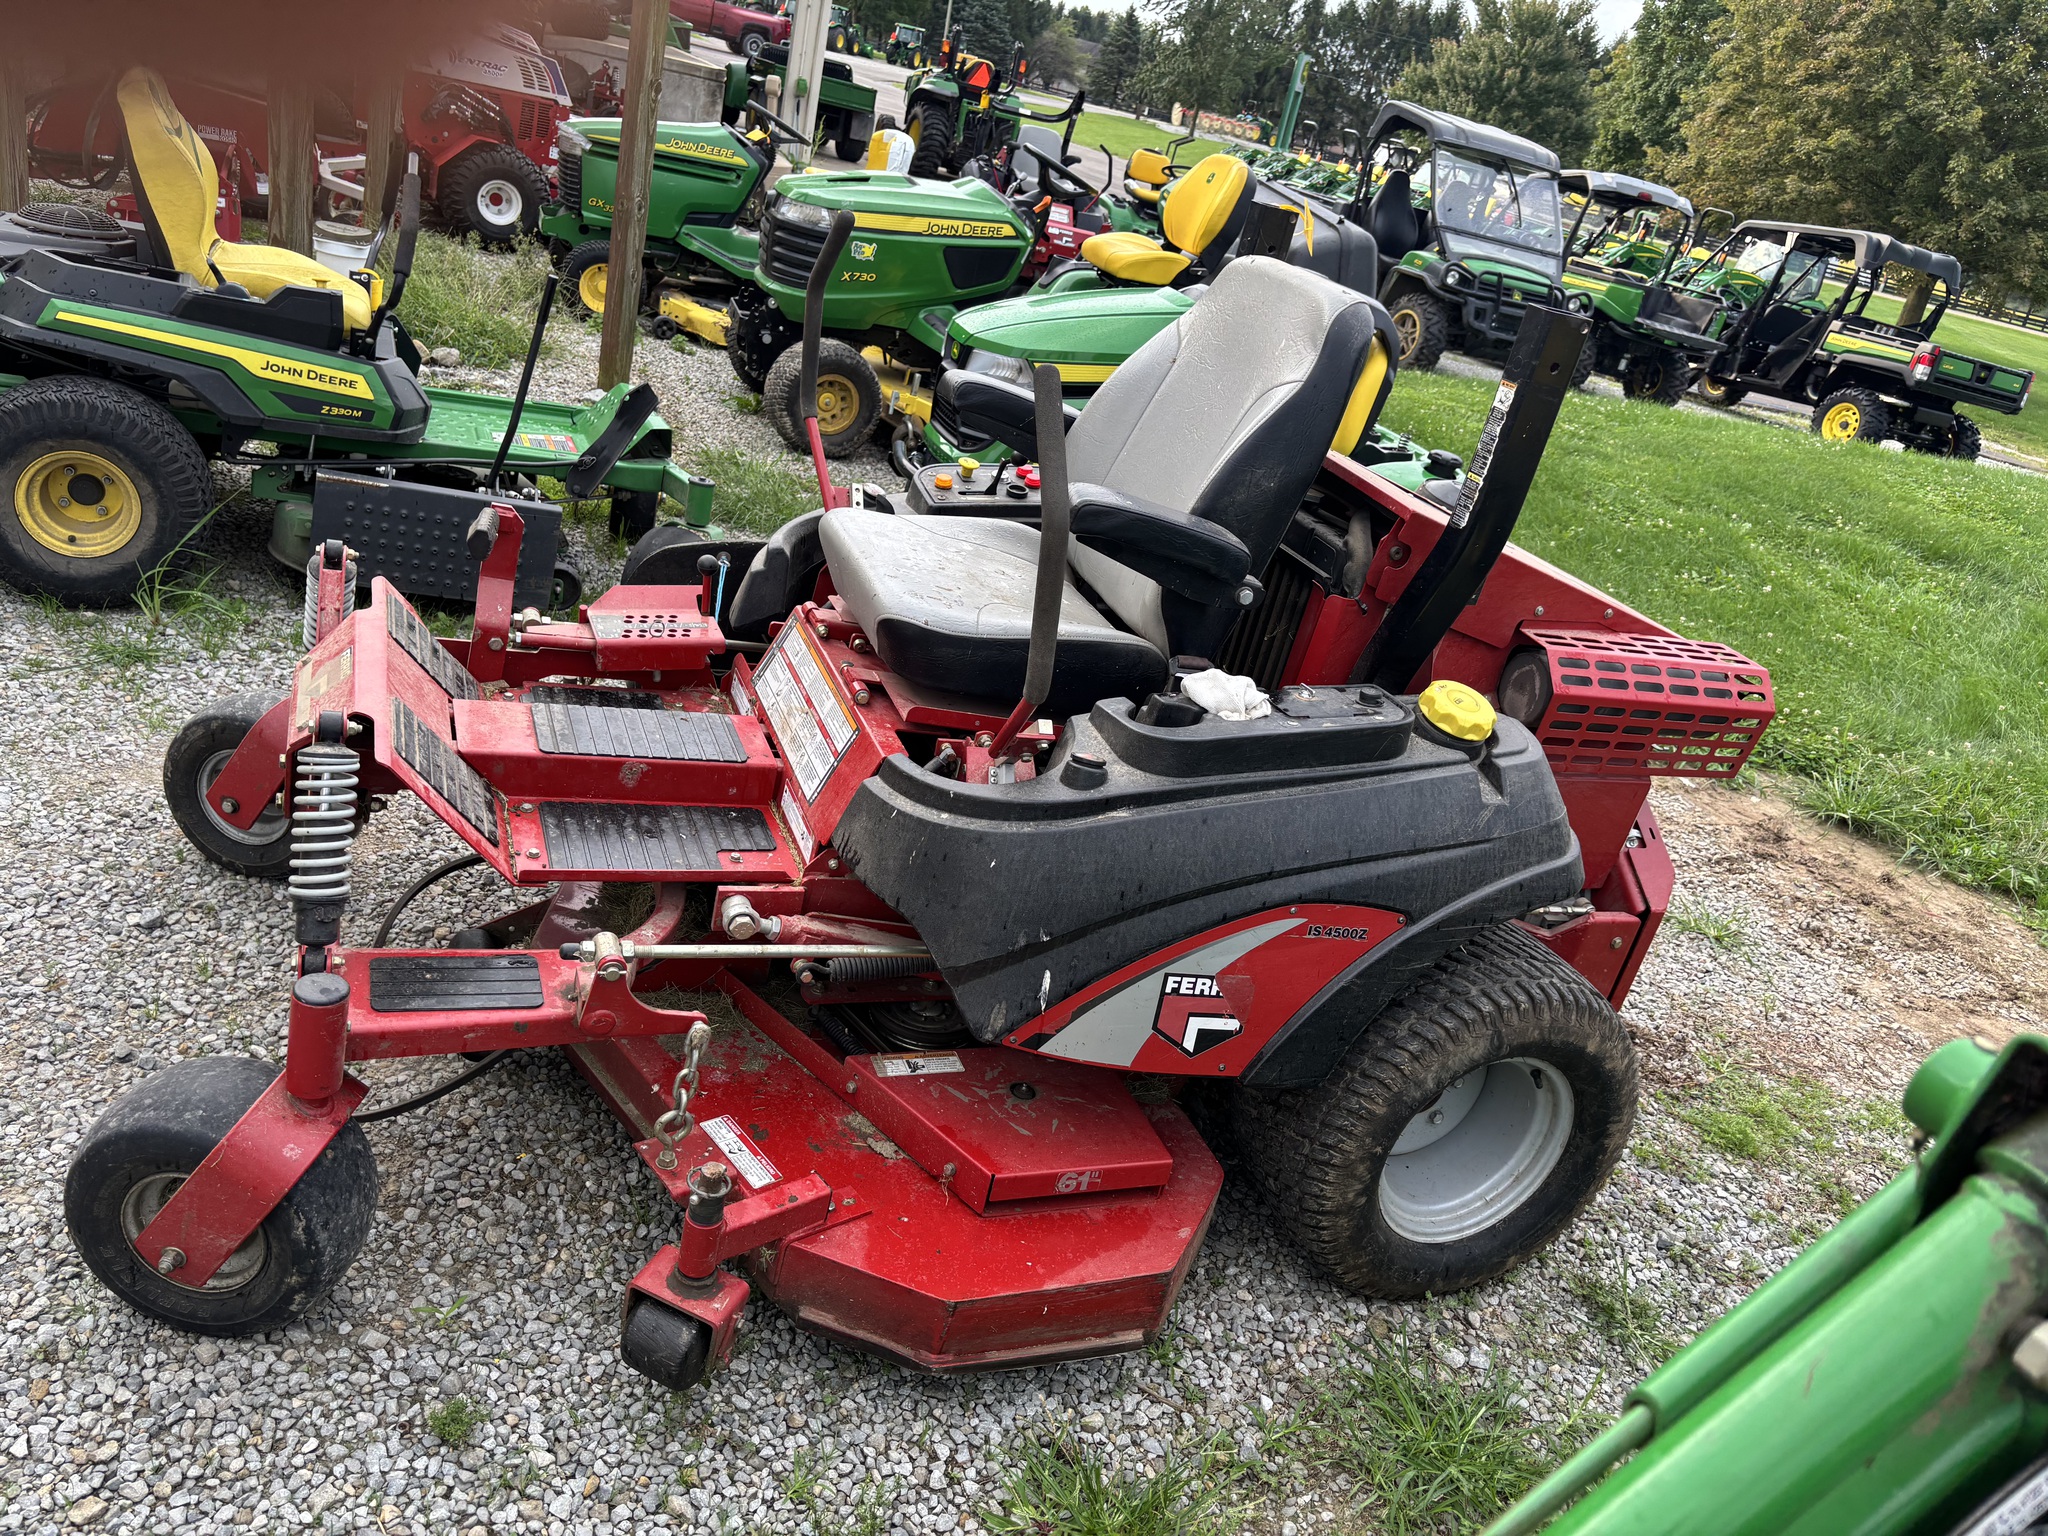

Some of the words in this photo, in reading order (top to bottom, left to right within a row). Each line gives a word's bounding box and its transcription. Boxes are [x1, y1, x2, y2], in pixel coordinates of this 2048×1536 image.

[665, 137, 697, 152] JOHN
[697, 142, 735, 159] DEERE
[588, 197, 615, 213] GX33
[921, 221, 959, 236] JOHN
[961, 223, 1004, 237] DEERE
[841, 271, 877, 282] X730
[260, 360, 303, 379] JOHN
[307, 369, 358, 389] DEERE
[321, 405, 362, 418] Z330M
[1307, 924, 1322, 937] IS
[1324, 926, 1369, 940] 4500Z
[1164, 975, 1224, 997] FERR
